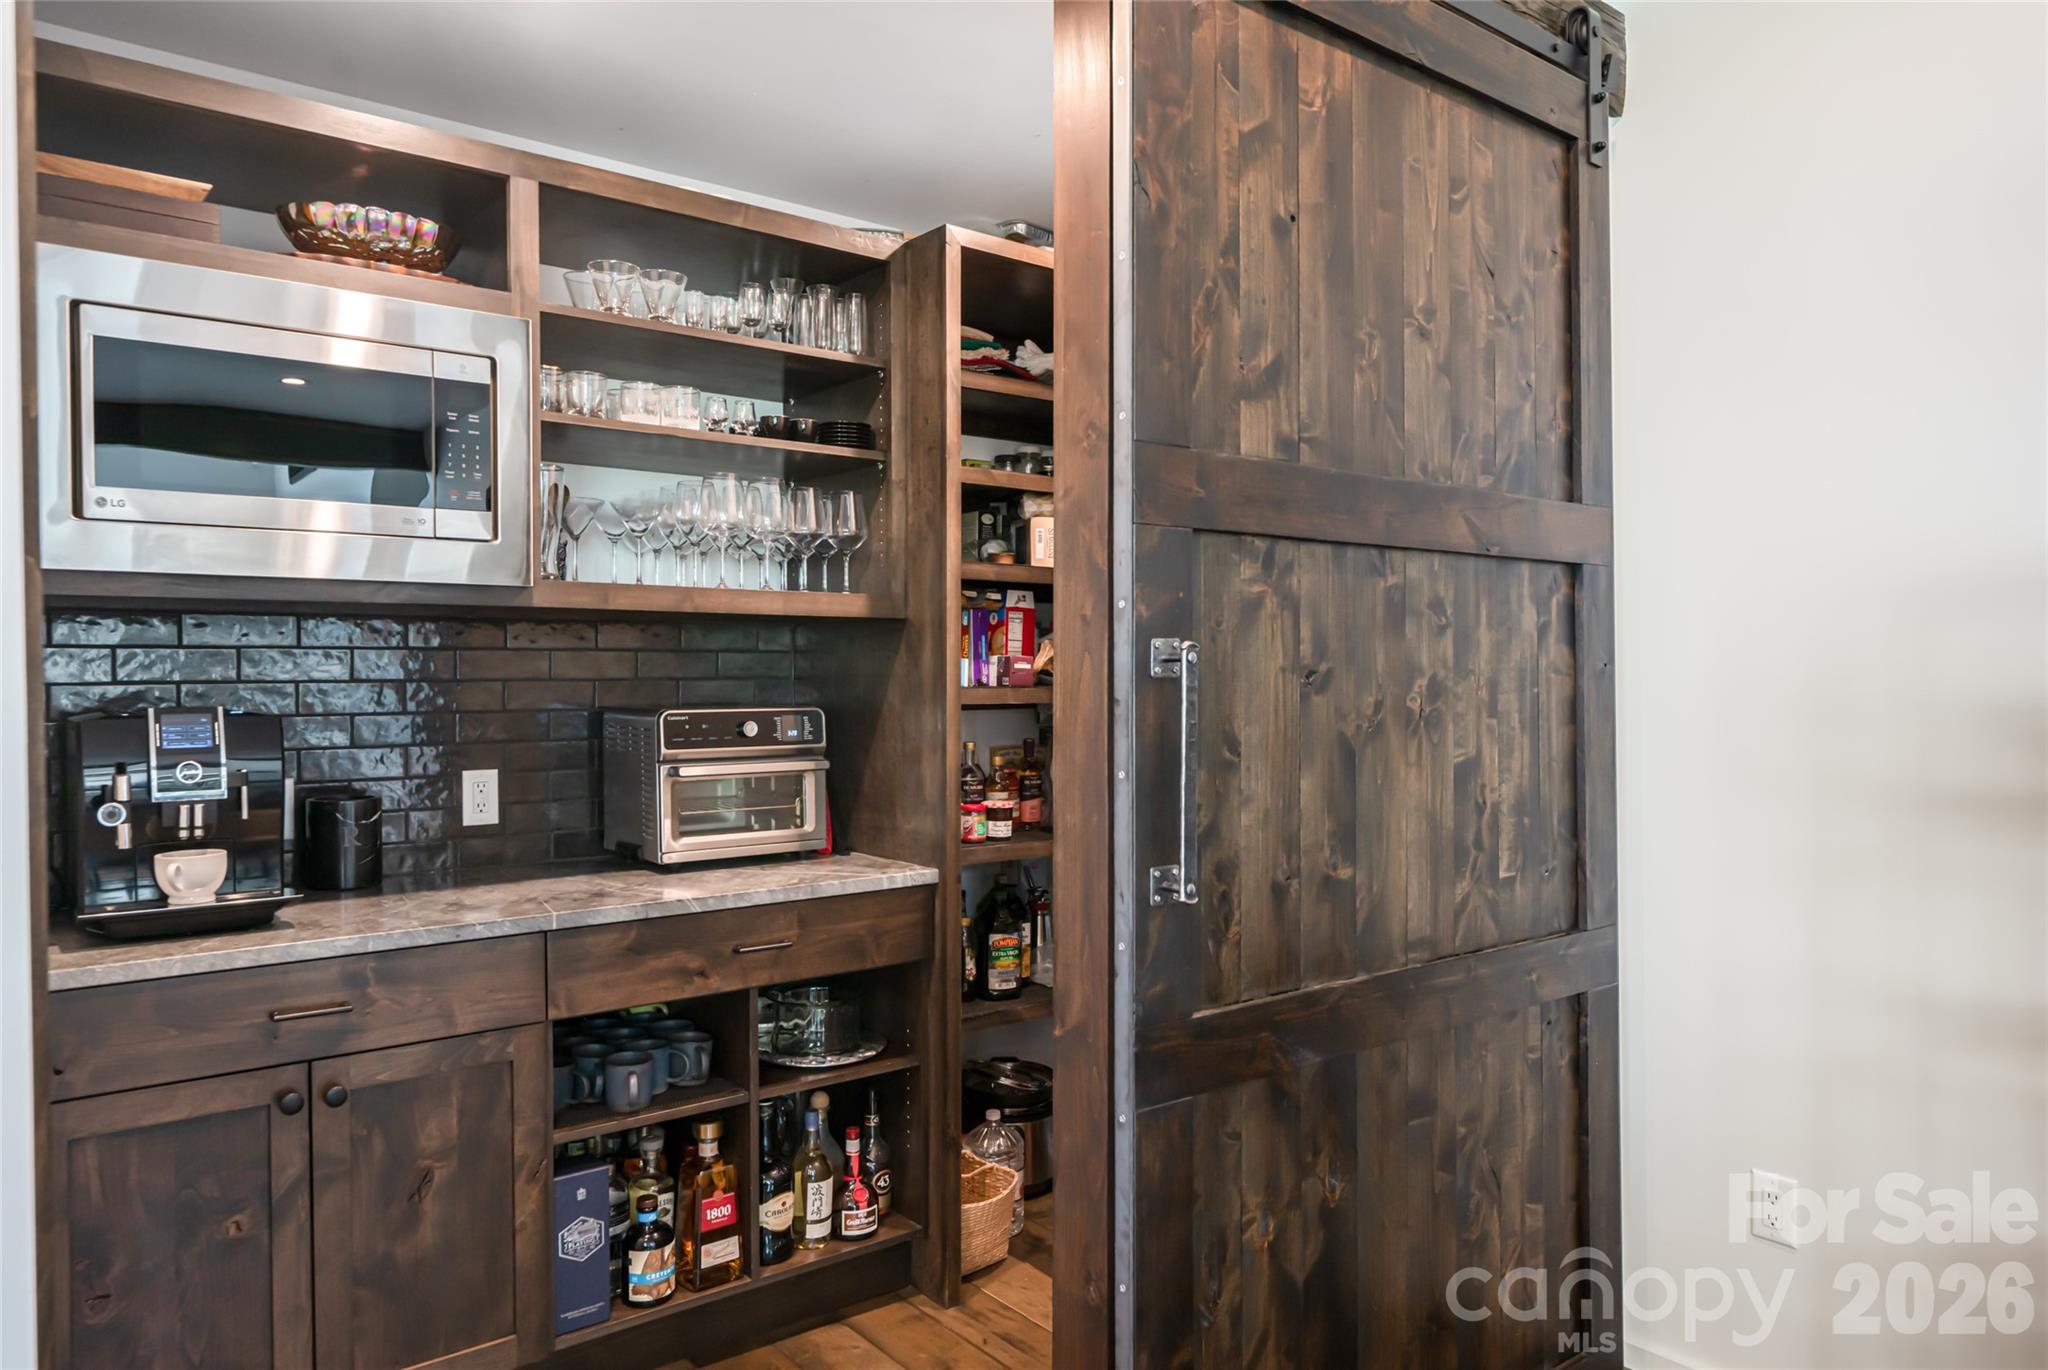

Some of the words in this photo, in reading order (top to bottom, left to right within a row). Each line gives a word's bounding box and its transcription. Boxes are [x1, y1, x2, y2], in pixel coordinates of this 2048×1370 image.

[110, 499, 126, 508] LG
[877, 1175, 890, 1188] 43
[706, 1204, 732, 1221] 1800
